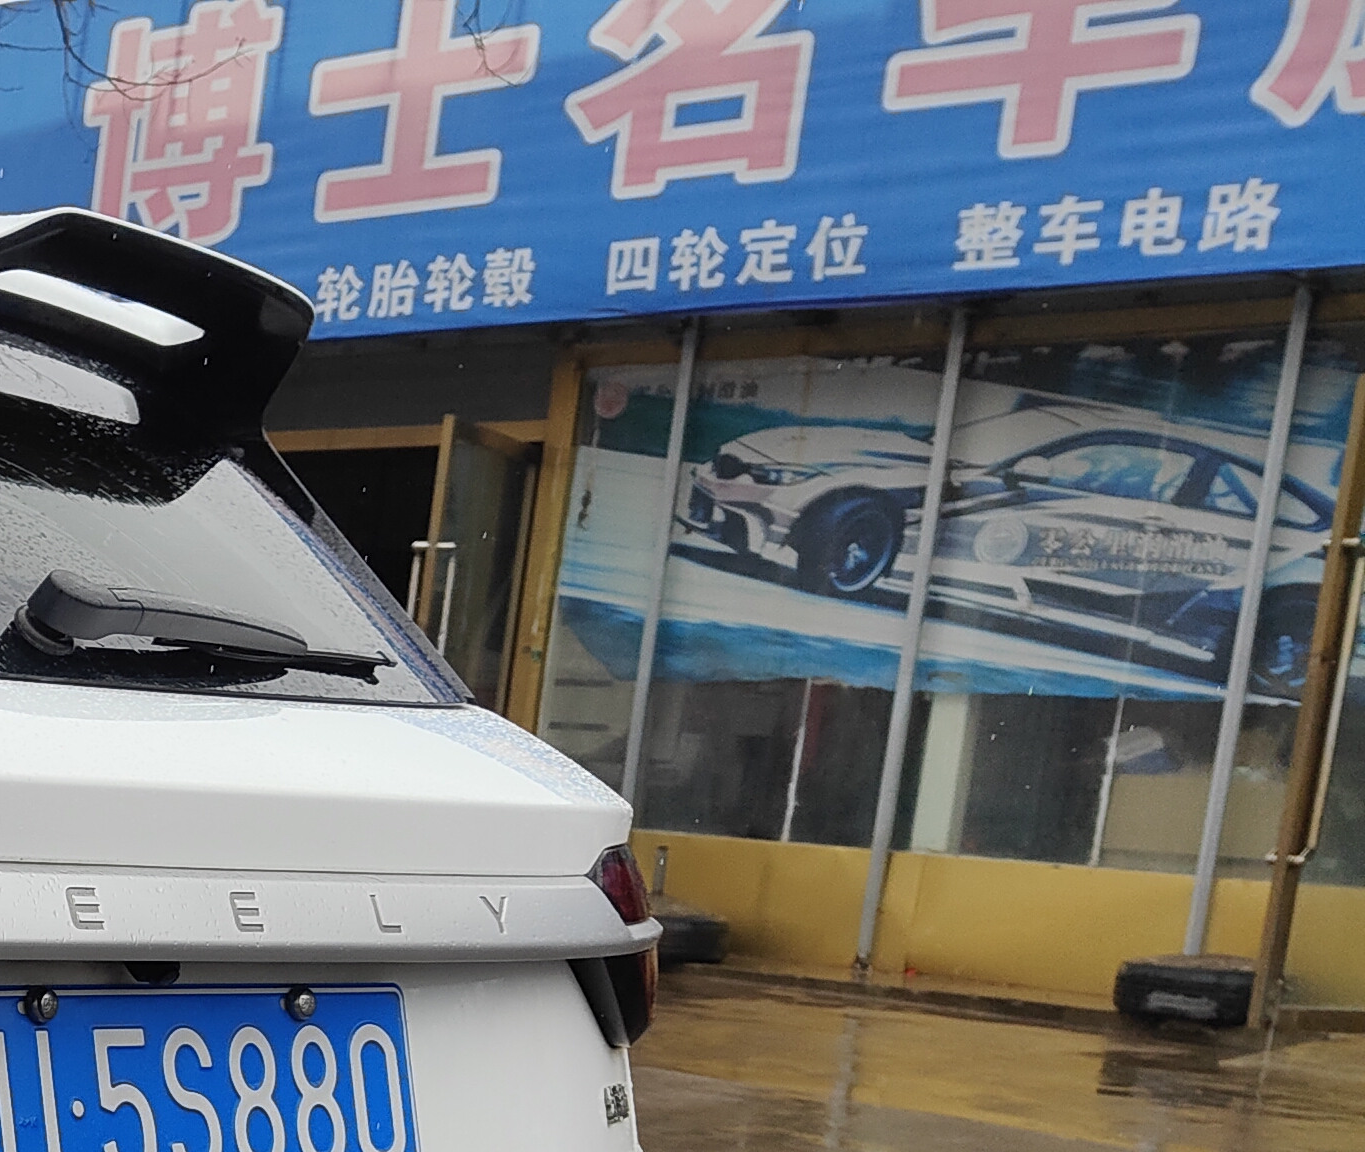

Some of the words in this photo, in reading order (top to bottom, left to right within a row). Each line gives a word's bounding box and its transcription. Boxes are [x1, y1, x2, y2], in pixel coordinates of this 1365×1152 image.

[316, 247, 536, 322] 轮胎轮毂
[606, 214, 867, 295] 四轮定位
[953, 179, 1282, 271] 整车电路
